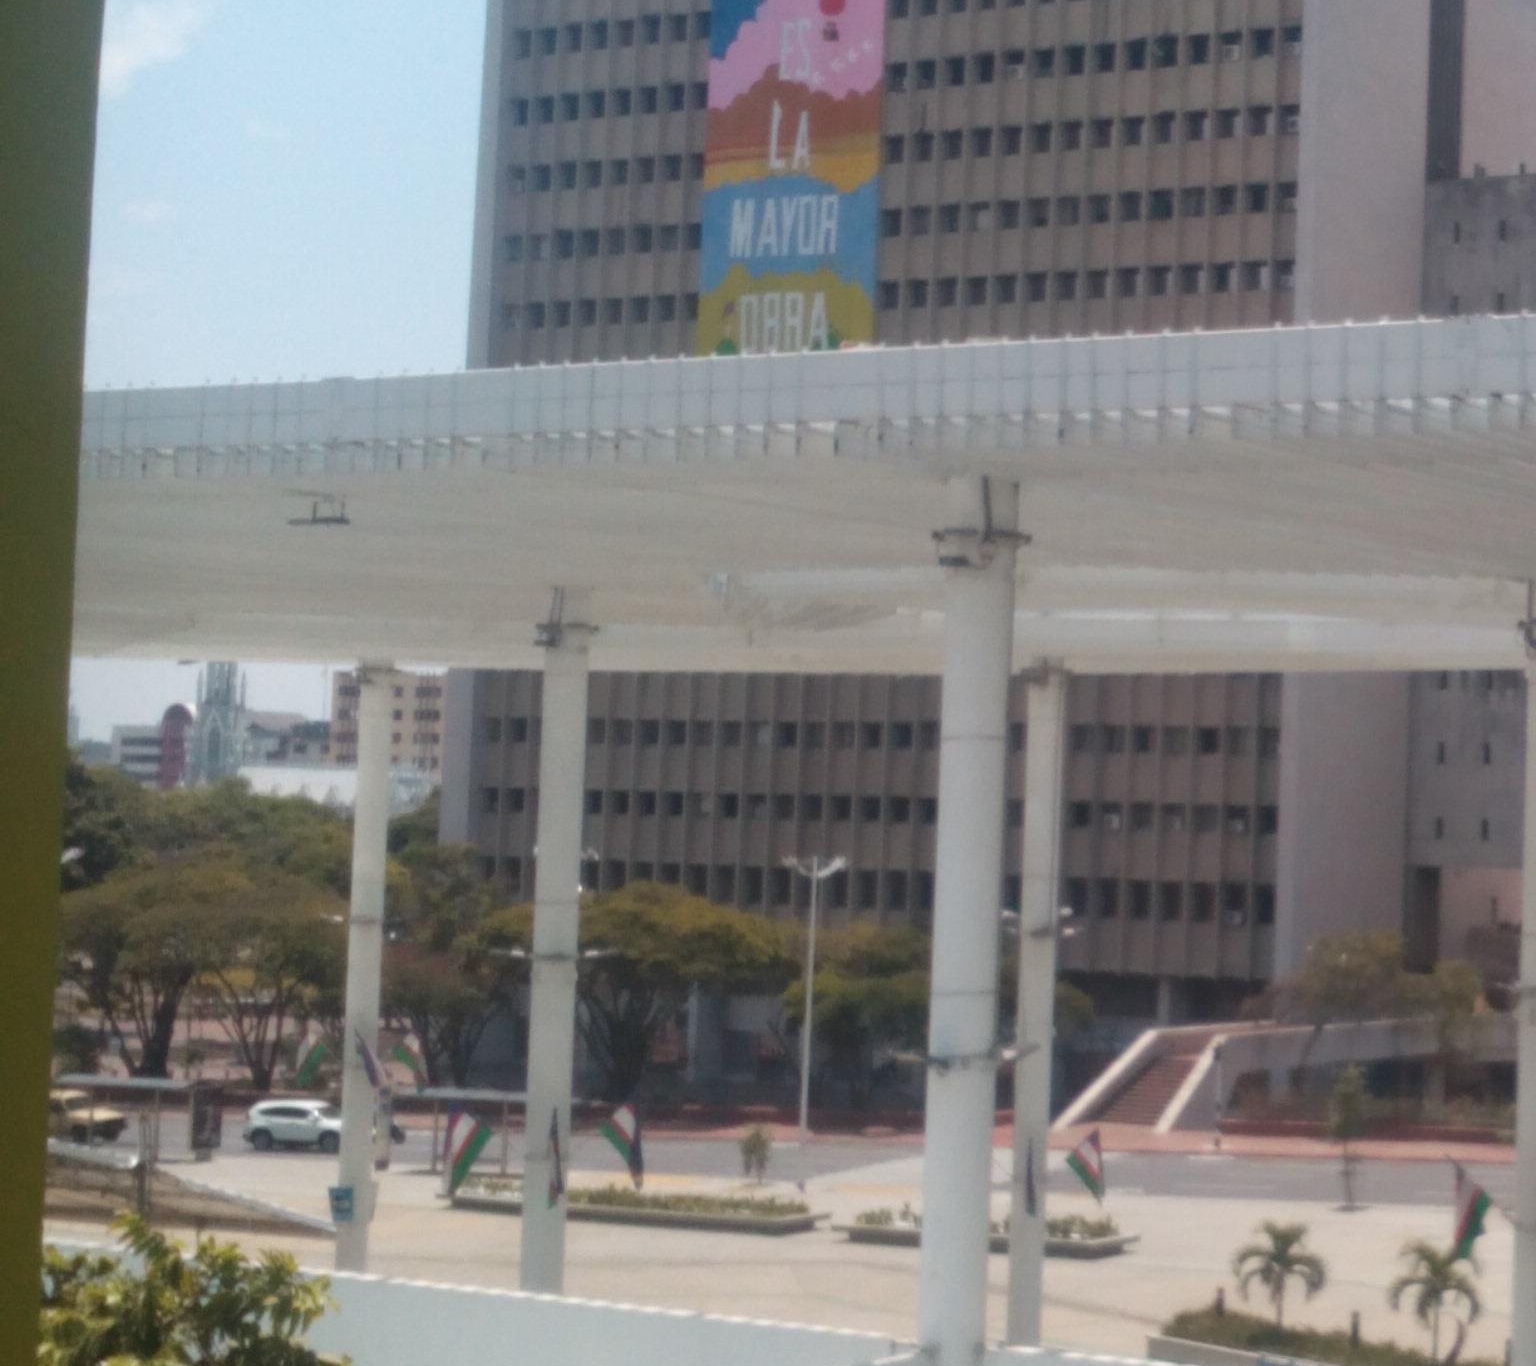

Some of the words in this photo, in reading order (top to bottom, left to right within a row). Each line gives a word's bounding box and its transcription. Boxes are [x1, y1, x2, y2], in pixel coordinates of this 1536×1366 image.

[778, 17, 812, 80] ES
[768, 98, 810, 171] LA
[729, 193, 840, 259] MAYOR
[739, 290, 829, 353] OBRA
